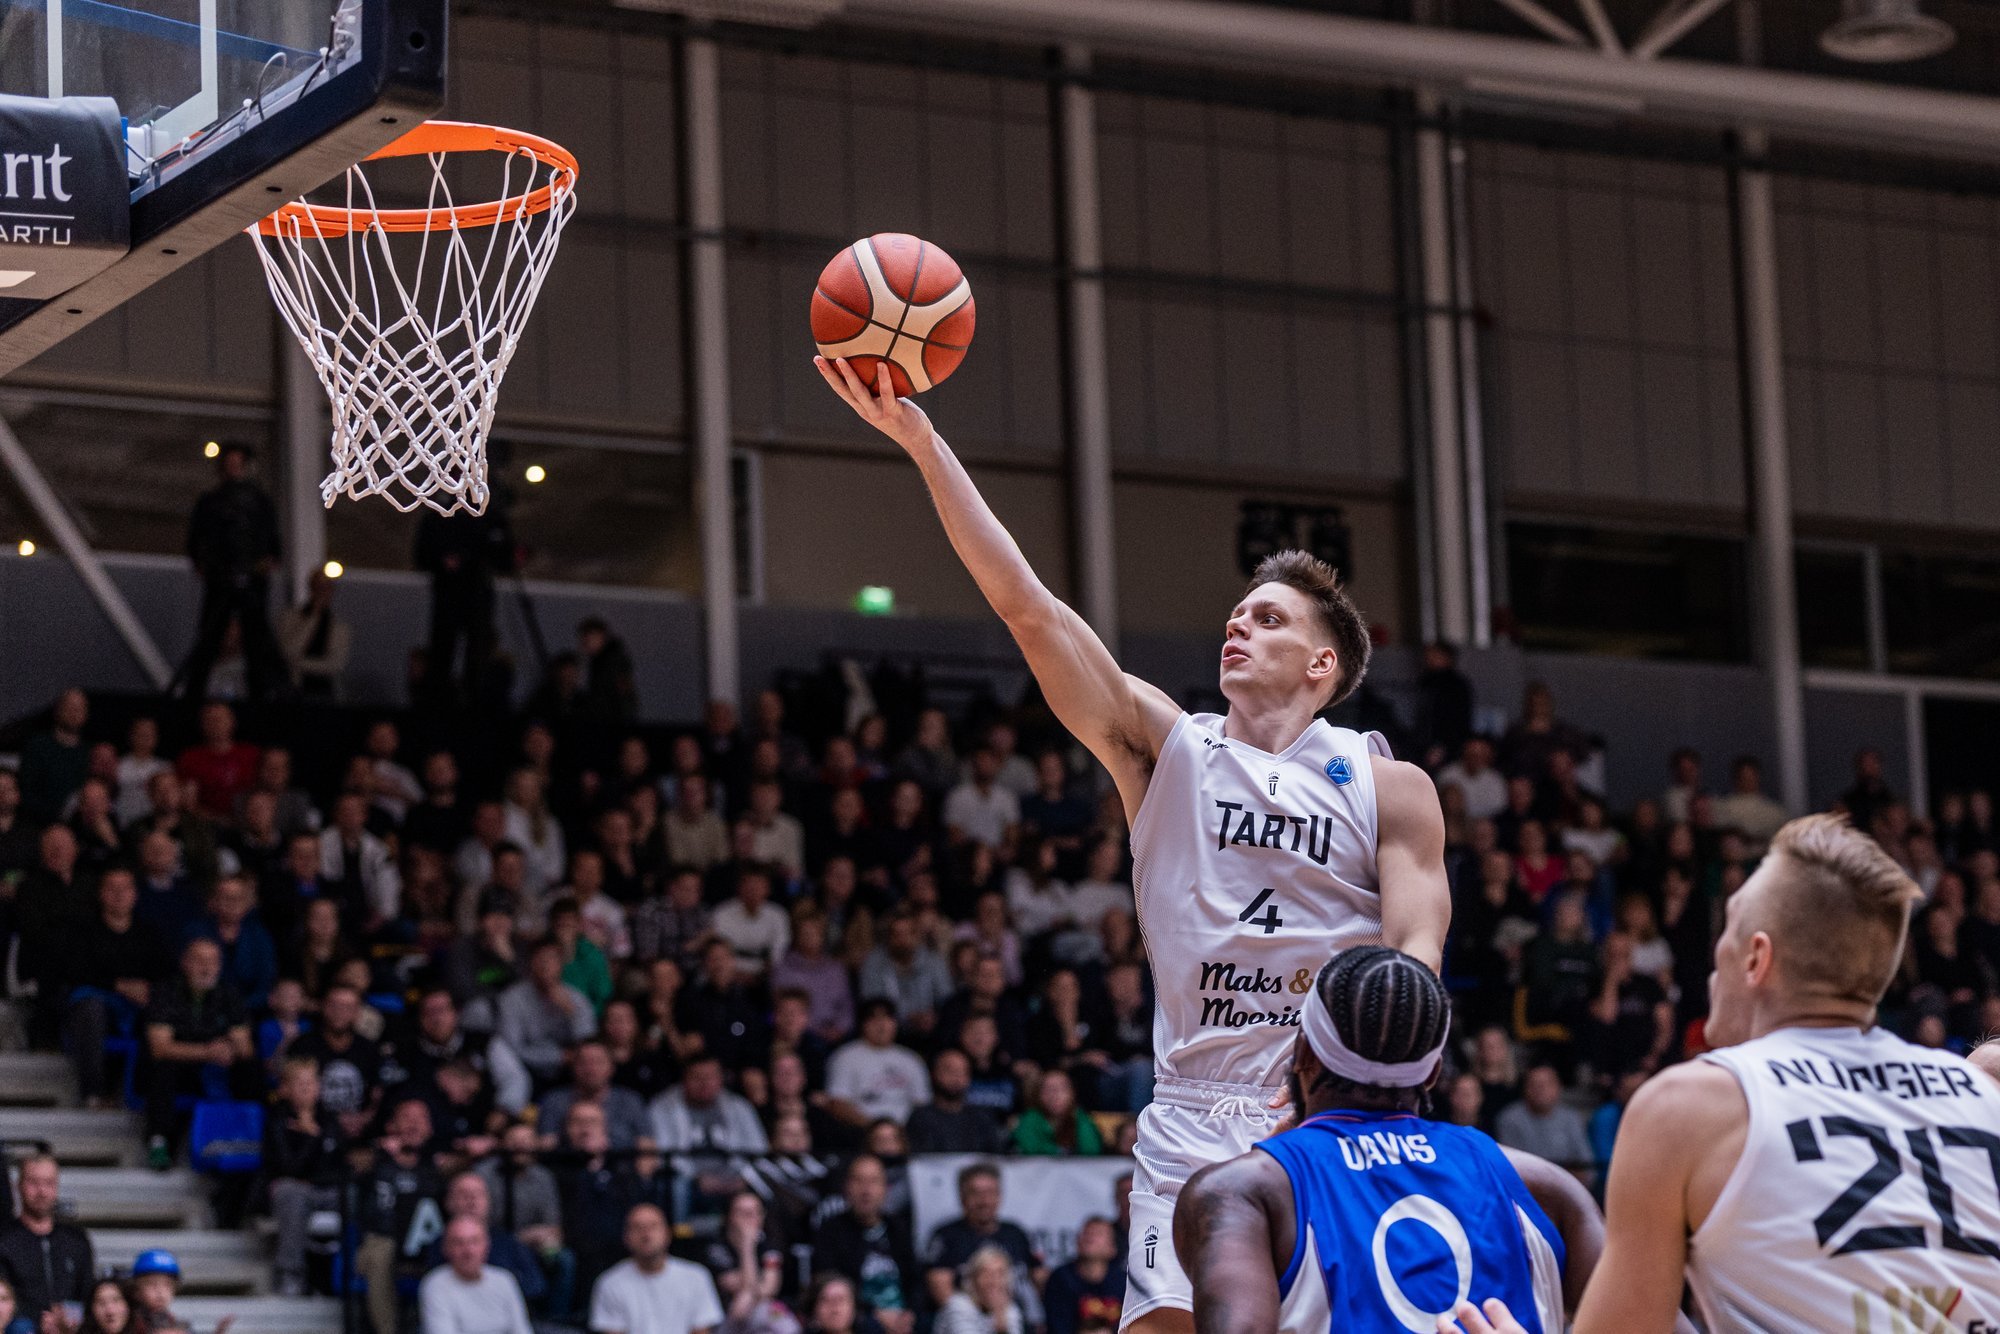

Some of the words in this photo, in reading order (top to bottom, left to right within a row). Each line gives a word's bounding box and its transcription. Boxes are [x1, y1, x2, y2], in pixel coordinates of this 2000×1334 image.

[1215, 800, 1333, 866] TARTU
[1238, 888, 1283, 934] 4
[1199, 962, 1283, 994] Maks
[1288, 968, 1314, 994] &
[1337, 1131, 1437, 1171] DAVIS
[1785, 1115, 2000, 1259] 20
